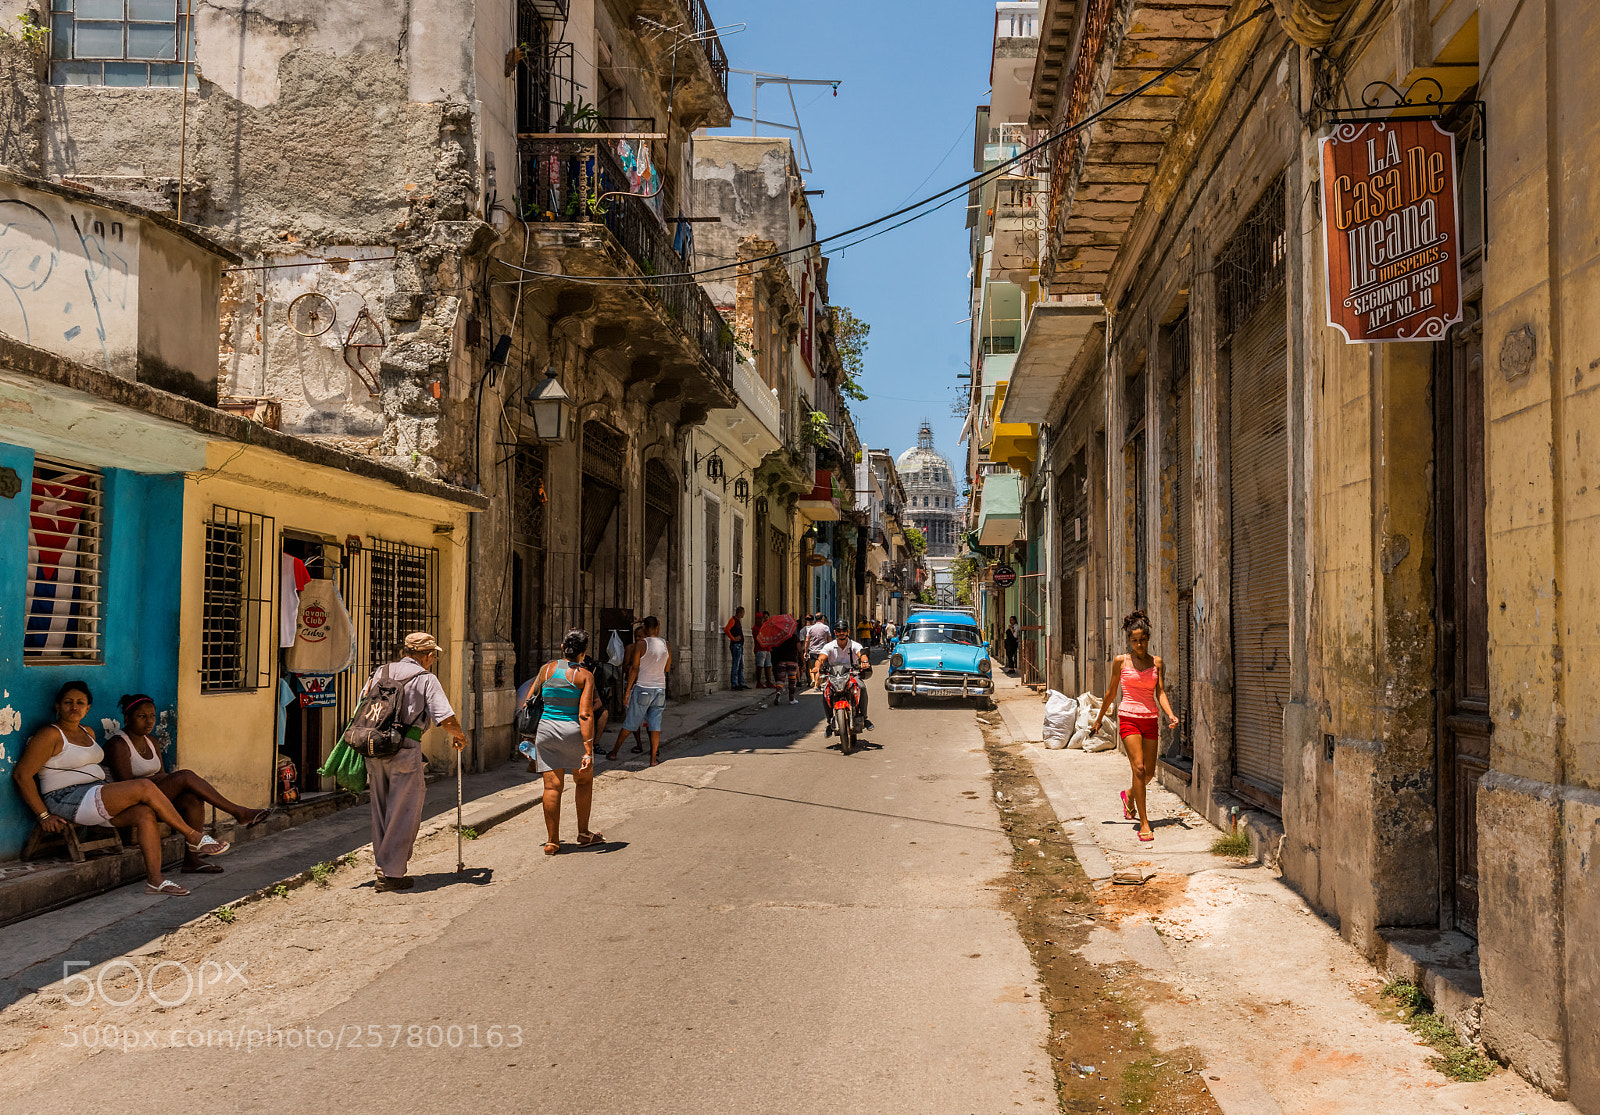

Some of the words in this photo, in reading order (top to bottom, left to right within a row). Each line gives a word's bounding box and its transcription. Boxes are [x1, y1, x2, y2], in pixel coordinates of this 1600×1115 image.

[1366, 129, 1402, 176] LA
[1334, 168, 1403, 230] Casa
[1407, 145, 1445, 203] De
[1380, 246, 1439, 283] HUESPEDES
[1354, 279, 1408, 316] SEGUNDO
[1412, 266, 1439, 292] PISO
[1368, 303, 1393, 330] APT
[1396, 296, 1416, 318] NO.
[1419, 287, 1432, 309] 10
[301, 627, 325, 638] Cuba
[305, 615, 323, 625] Club
[365, 702, 384, 722] NY
